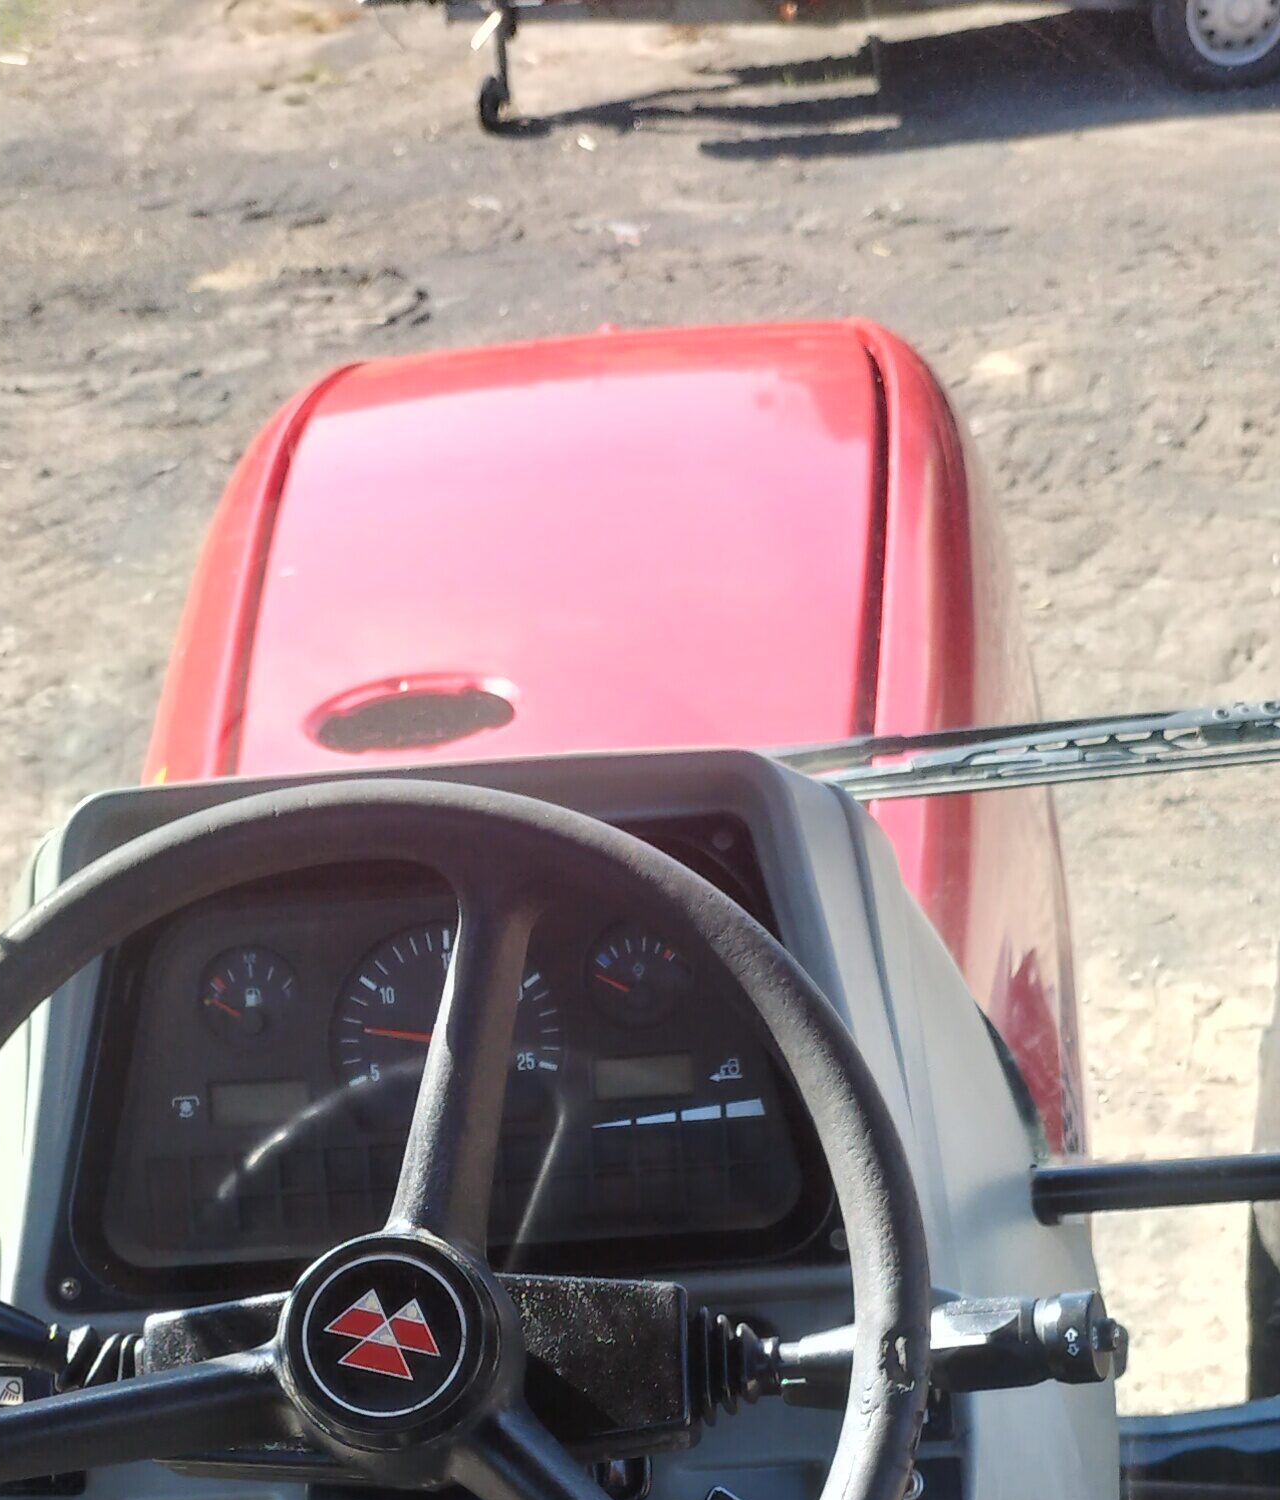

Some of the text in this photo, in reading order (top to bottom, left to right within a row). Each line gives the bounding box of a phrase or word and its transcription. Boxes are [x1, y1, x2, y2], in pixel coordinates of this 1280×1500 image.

[379, 986, 395, 1004] 10
[516, 1052, 536, 1071] 25
[370, 1064, 380, 1082] 5
